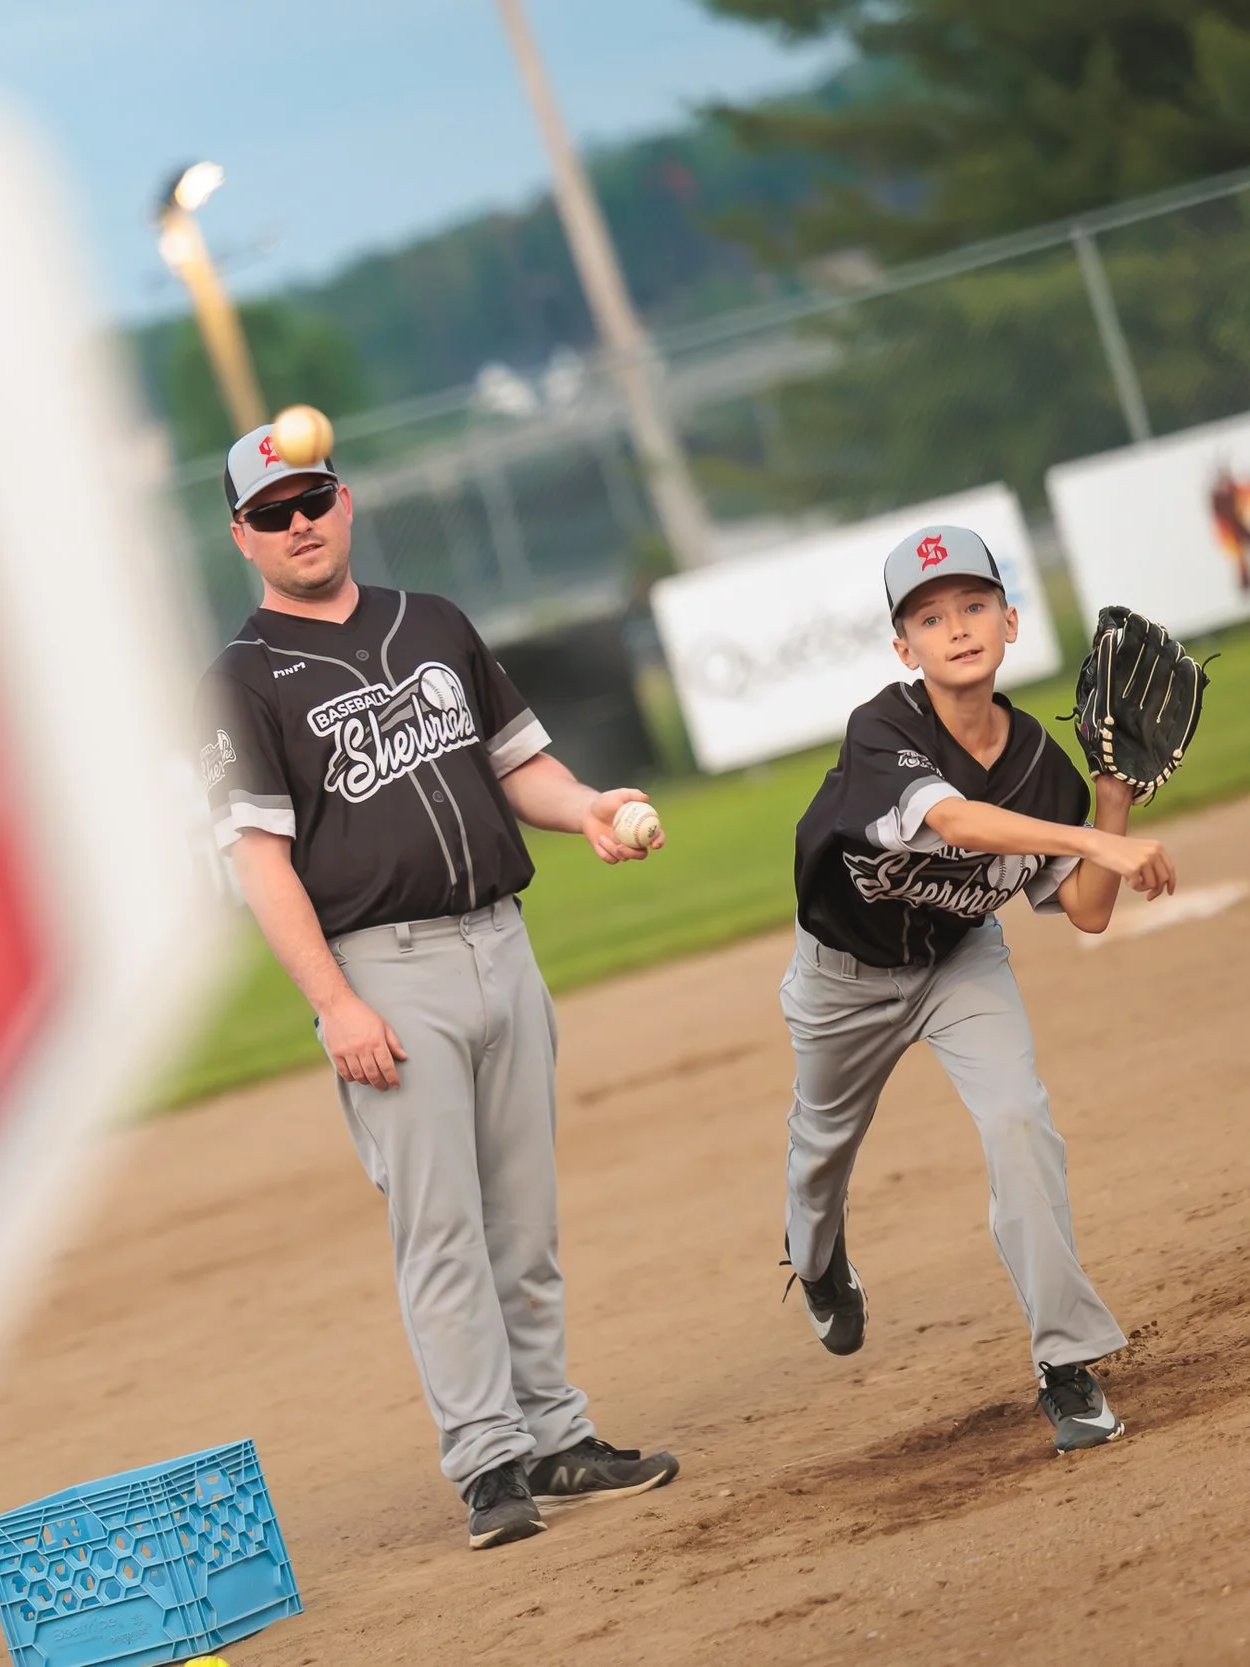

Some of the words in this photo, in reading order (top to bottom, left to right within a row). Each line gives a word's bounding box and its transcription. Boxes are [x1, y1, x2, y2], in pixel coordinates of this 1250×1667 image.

[916, 533, 948, 571] S
[272, 661, 306, 679] MNM
[315, 690, 391, 729] BASEBALL
